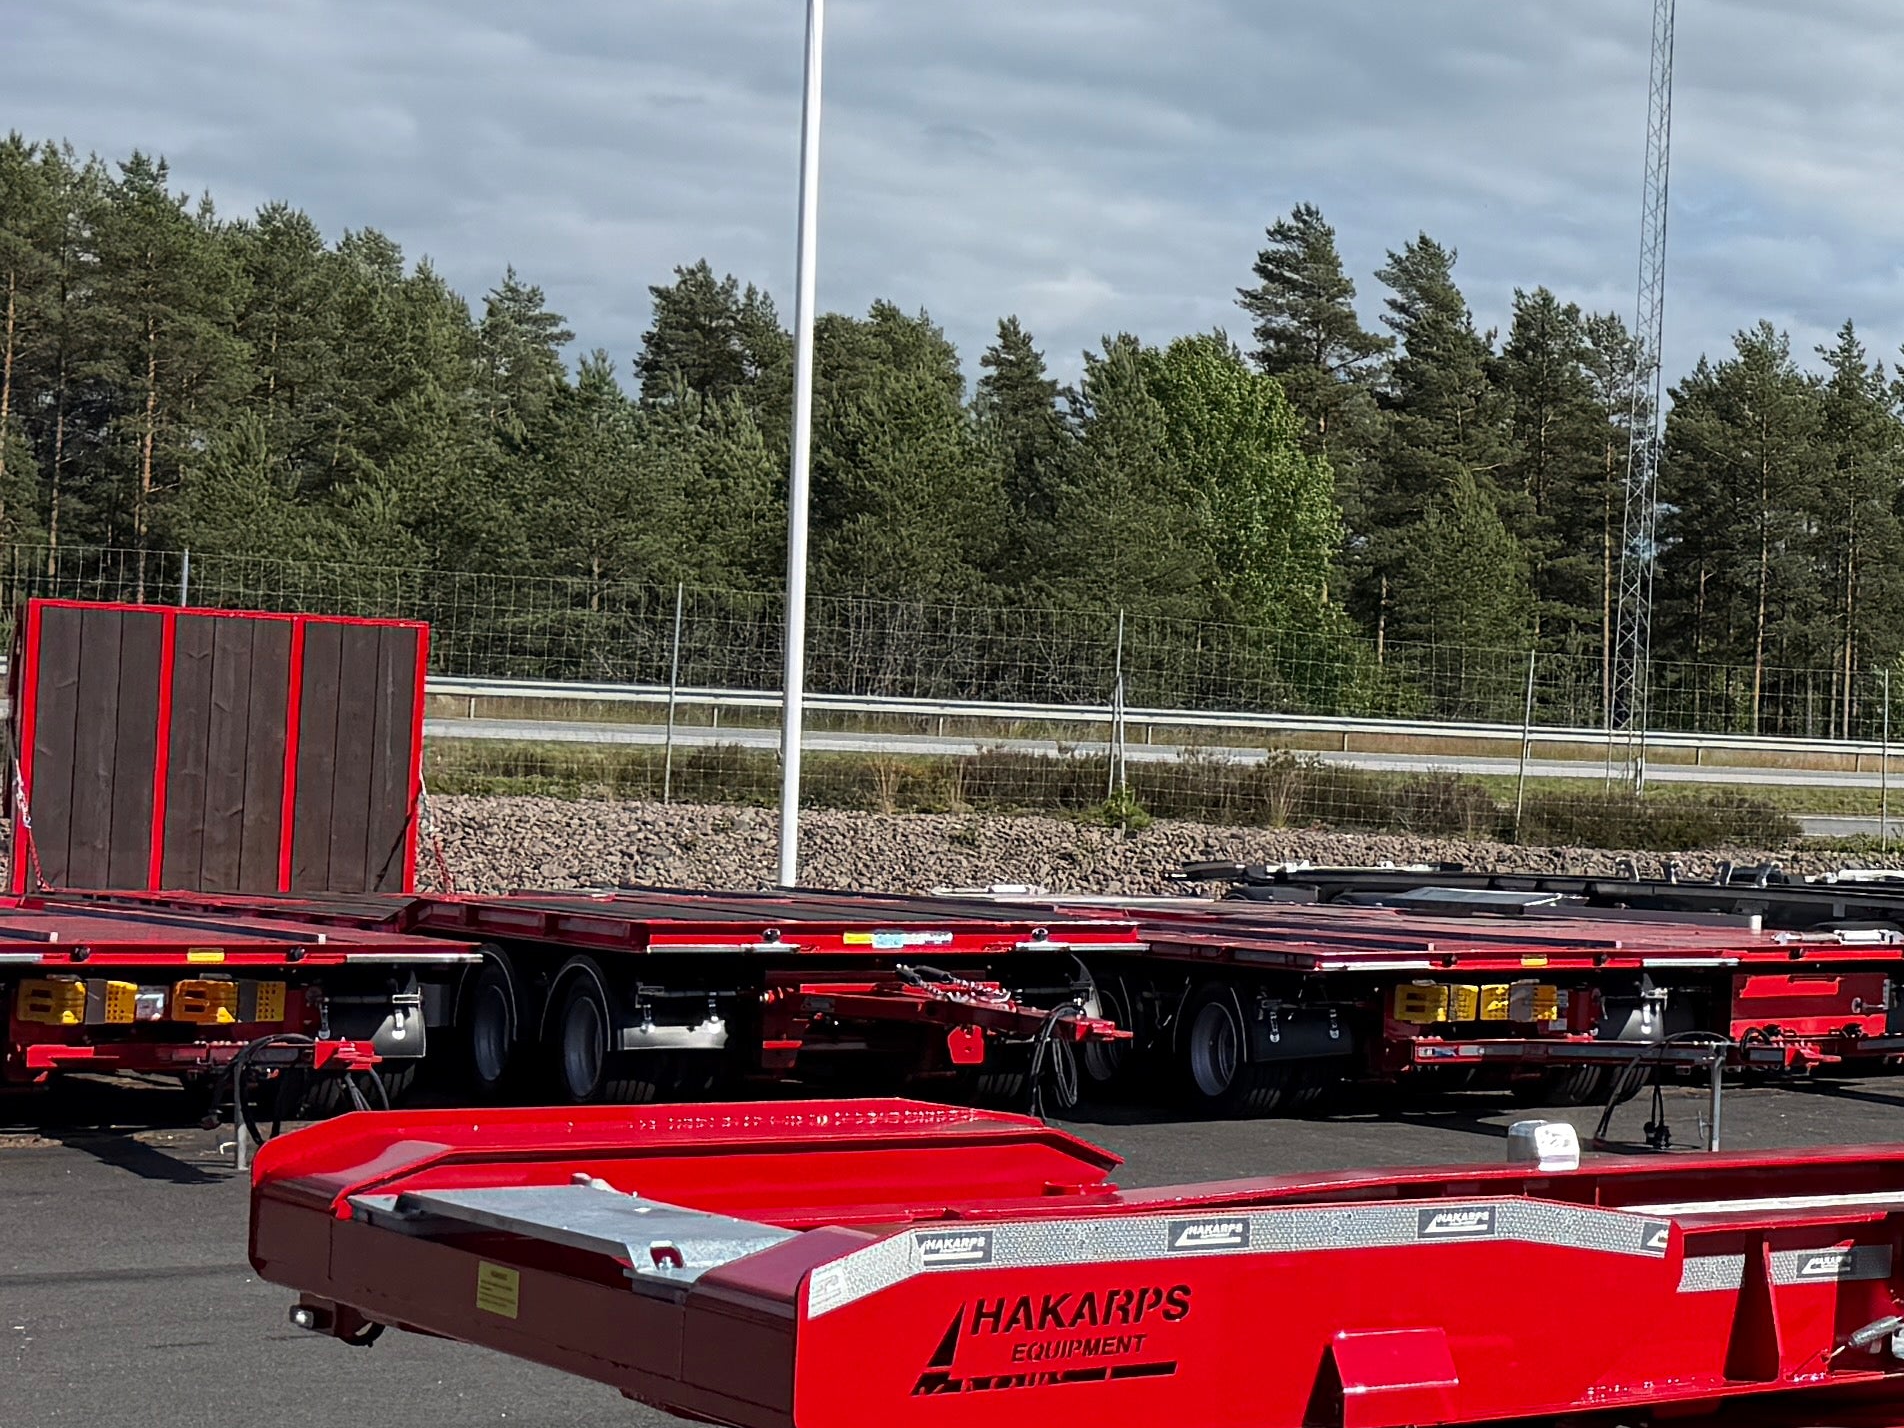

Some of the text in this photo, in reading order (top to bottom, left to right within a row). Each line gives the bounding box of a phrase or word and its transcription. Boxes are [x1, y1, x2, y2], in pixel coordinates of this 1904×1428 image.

[1187, 1222, 1243, 1236] HAKARPS
[925, 1235, 986, 1252] HAKARPS
[969, 1283, 1192, 1337] HAKARPS
[1011, 1333, 1147, 1363] EQUIPMENT
